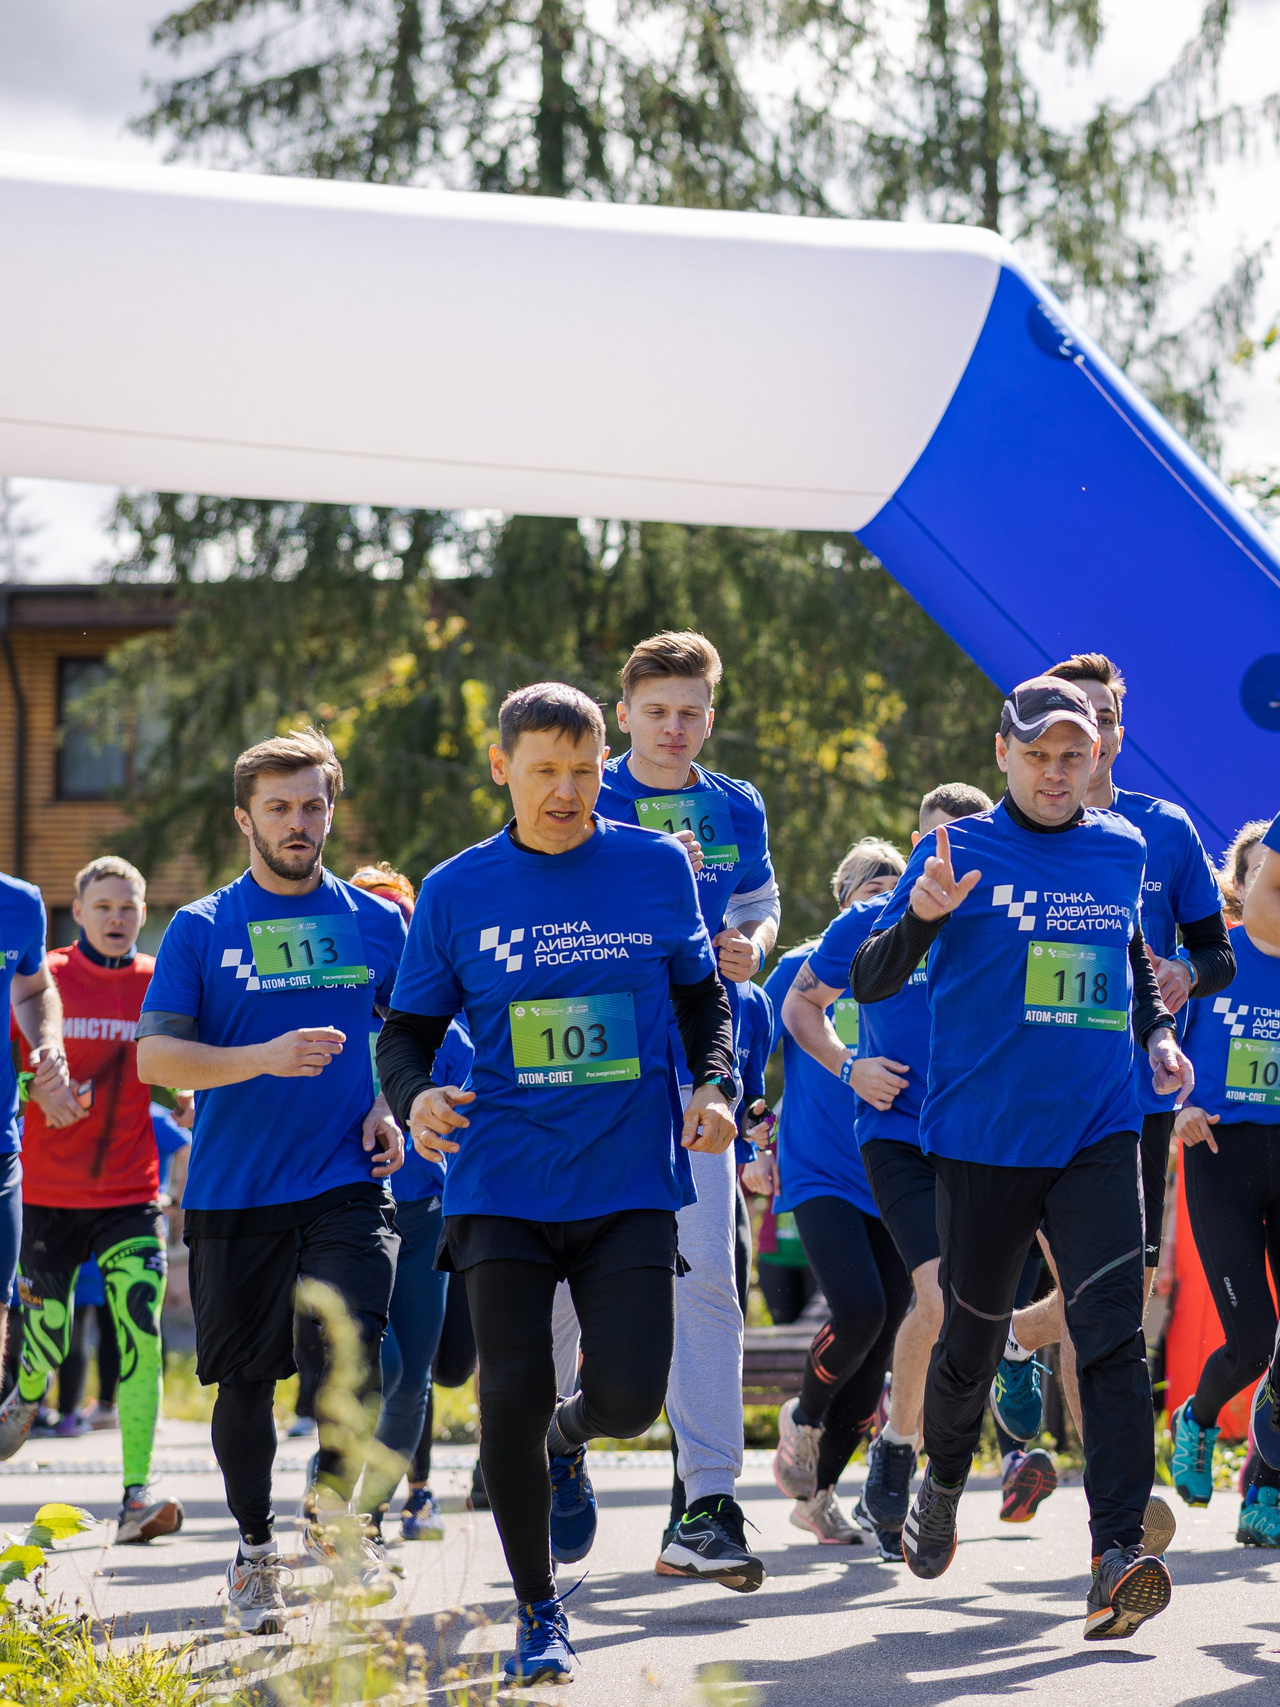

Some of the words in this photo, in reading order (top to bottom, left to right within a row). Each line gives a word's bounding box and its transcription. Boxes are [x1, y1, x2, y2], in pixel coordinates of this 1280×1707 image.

[1043, 892, 1095, 903] ГОНКА
[1046, 904, 1131, 919] ДИВИЗИОНОВ
[532, 920, 592, 938] ГОНКА
[1046, 919, 1123, 931] РОСАТОМА
[534, 932, 653, 954] ДИВИЗИОНОВ
[278, 937, 339, 969] 113
[535, 947, 630, 967] РОСАТОМА
[261, 974, 312, 990] АТОМ-СЛЕТ
[1053, 970, 1108, 1004] 118
[1025, 1010, 1078, 1024] АТОМ-СЛЕТ
[540, 1023, 608, 1061] 103
[518, 1070, 574, 1084] АТОМ-СЛЕТ
[586, 1068, 630, 1078] Росэнергоатом-1
[1225, 1090, 1266, 1102] АТОМ-СЛЕТ
[1223, 1276, 1237, 1300] CRAFT
